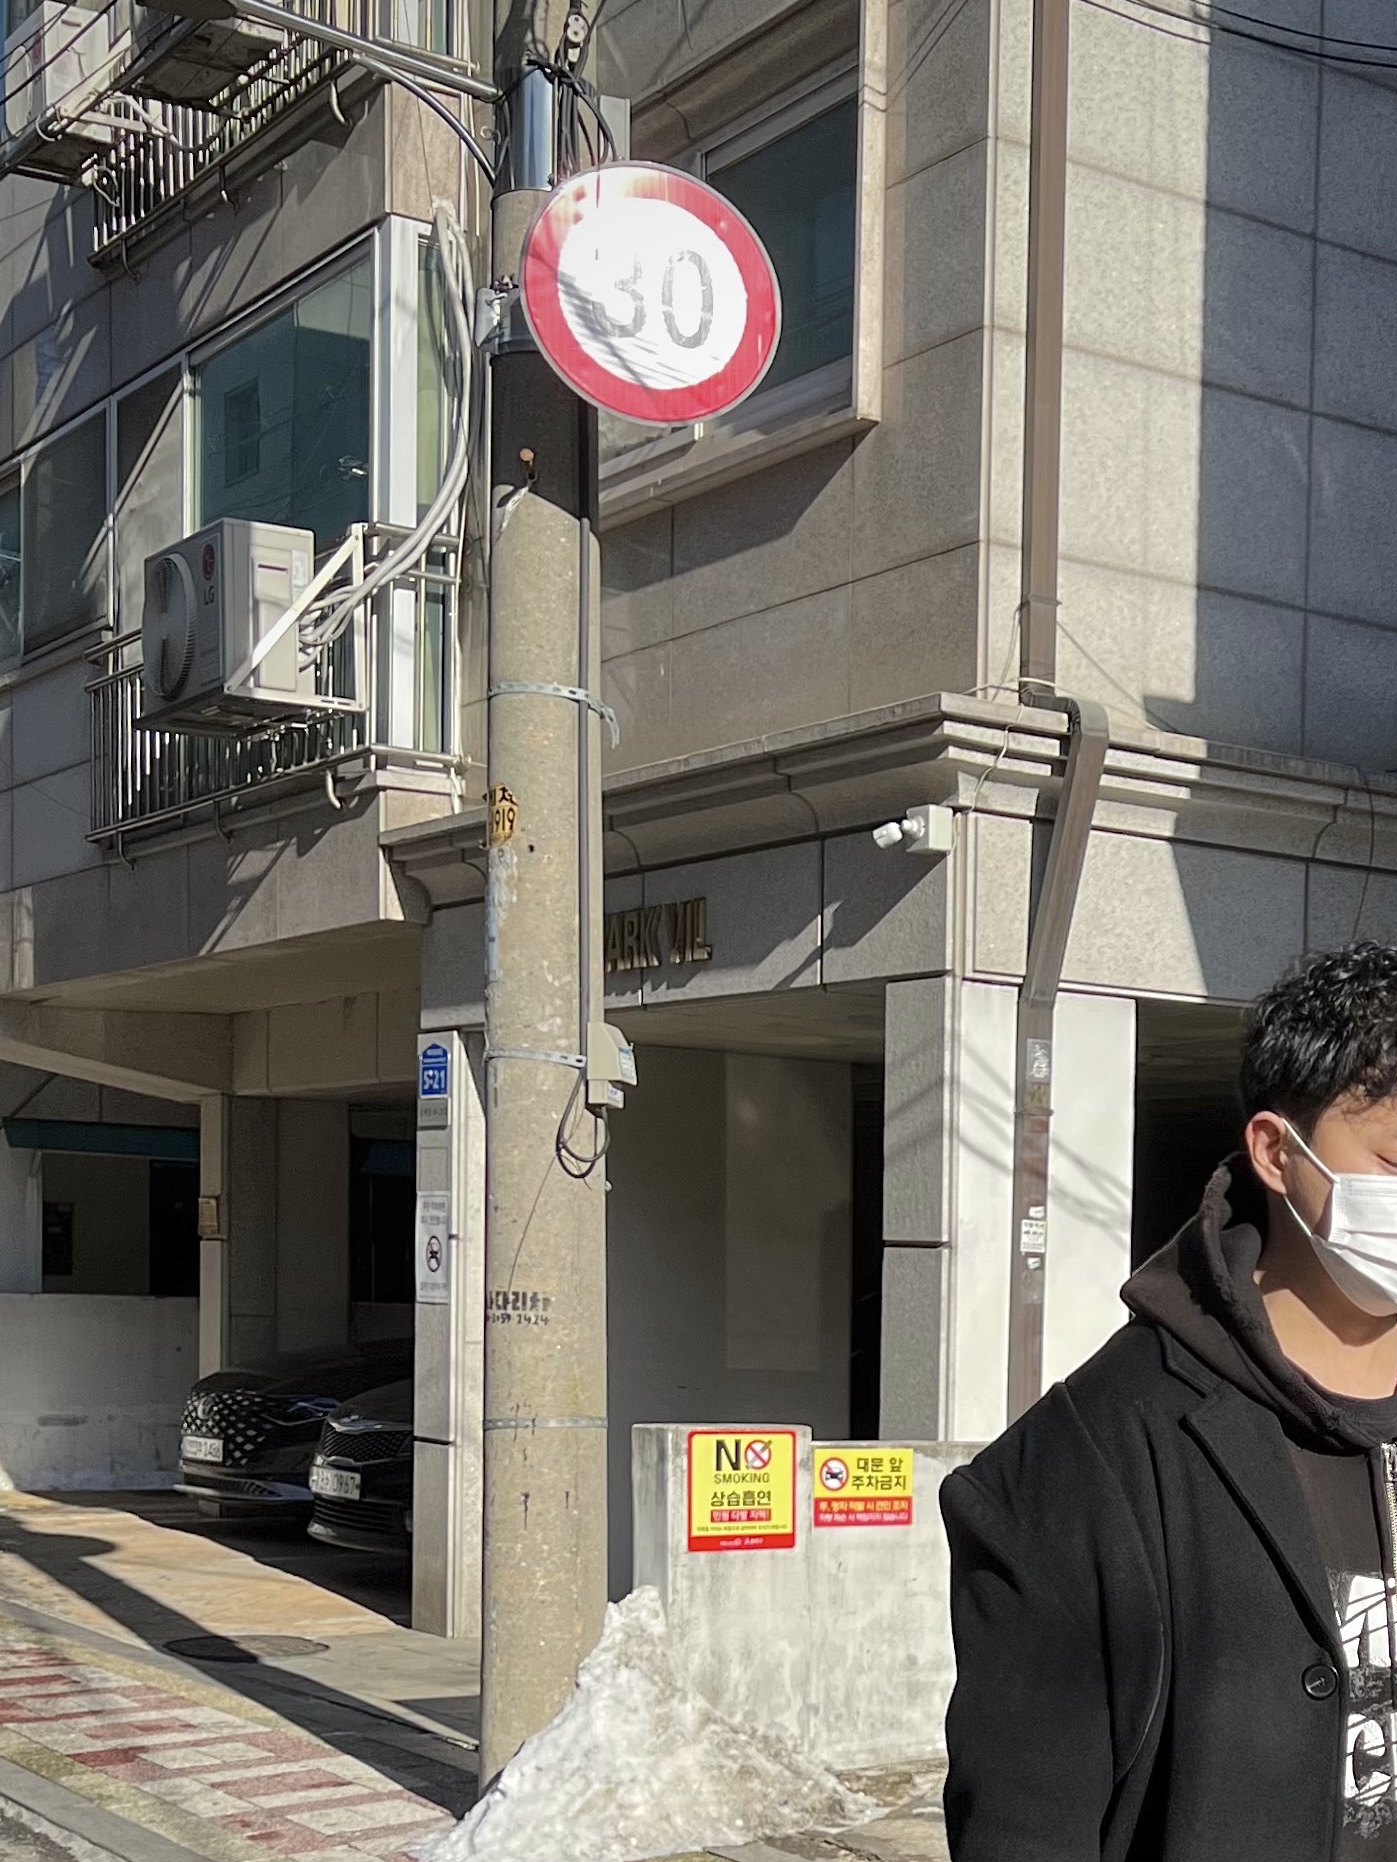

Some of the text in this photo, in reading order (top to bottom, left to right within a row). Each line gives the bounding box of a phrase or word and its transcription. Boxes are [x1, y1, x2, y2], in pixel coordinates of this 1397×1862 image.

[592, 250, 713, 349] 30
[857, 1457, 903, 1473] 대문 앞
[714, 1473, 770, 1484] SMOKING
[852, 1475, 906, 1491] 주차금지
[711, 1490, 771, 1507] 상습흡연
